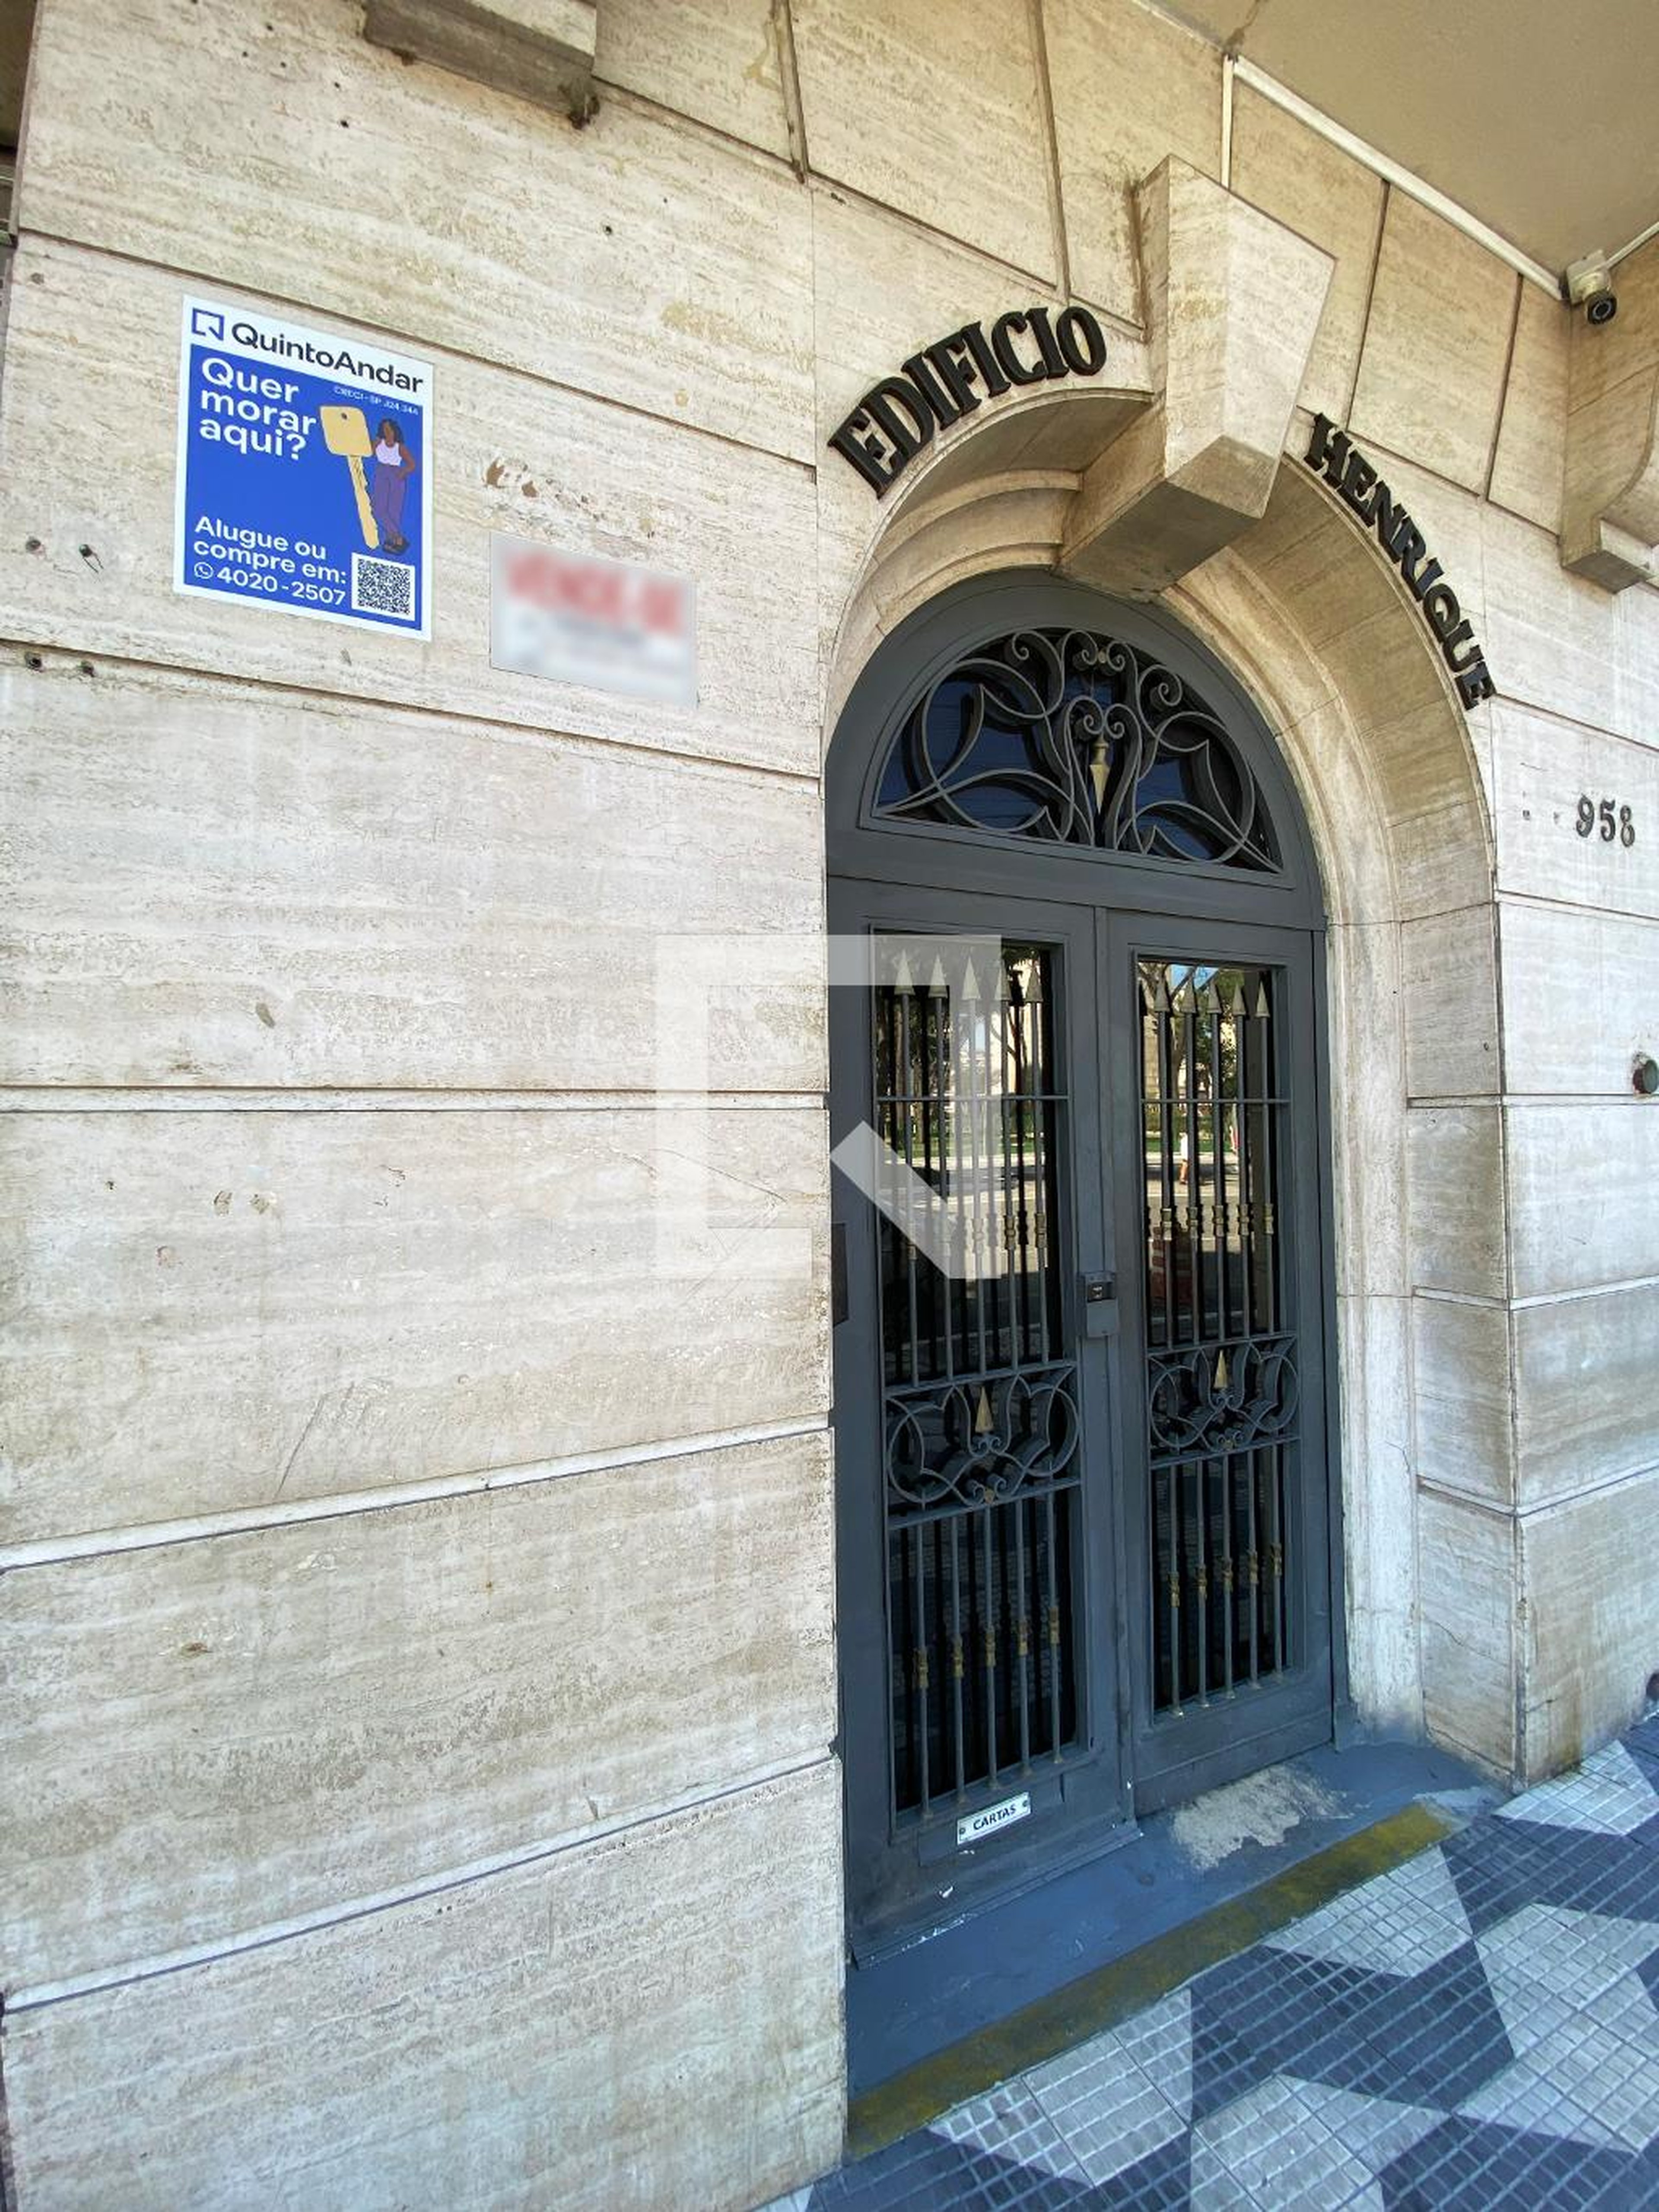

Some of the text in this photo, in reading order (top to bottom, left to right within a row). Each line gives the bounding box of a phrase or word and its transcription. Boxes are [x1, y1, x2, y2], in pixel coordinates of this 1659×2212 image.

[232, 322, 423, 392] QuintoAndar
[202, 358, 299, 403] Quer
[201, 389, 316, 435] morar
[200, 417, 307, 460] aqui?
[827, 306, 1497, 711] EDIFICIO HENRIQUE
[194, 516, 327, 560] Alugue ou
[194, 541, 346, 585] compre em:
[1576, 793, 1635, 848] 958
[973, 1804, 1016, 1830] CARTAS
